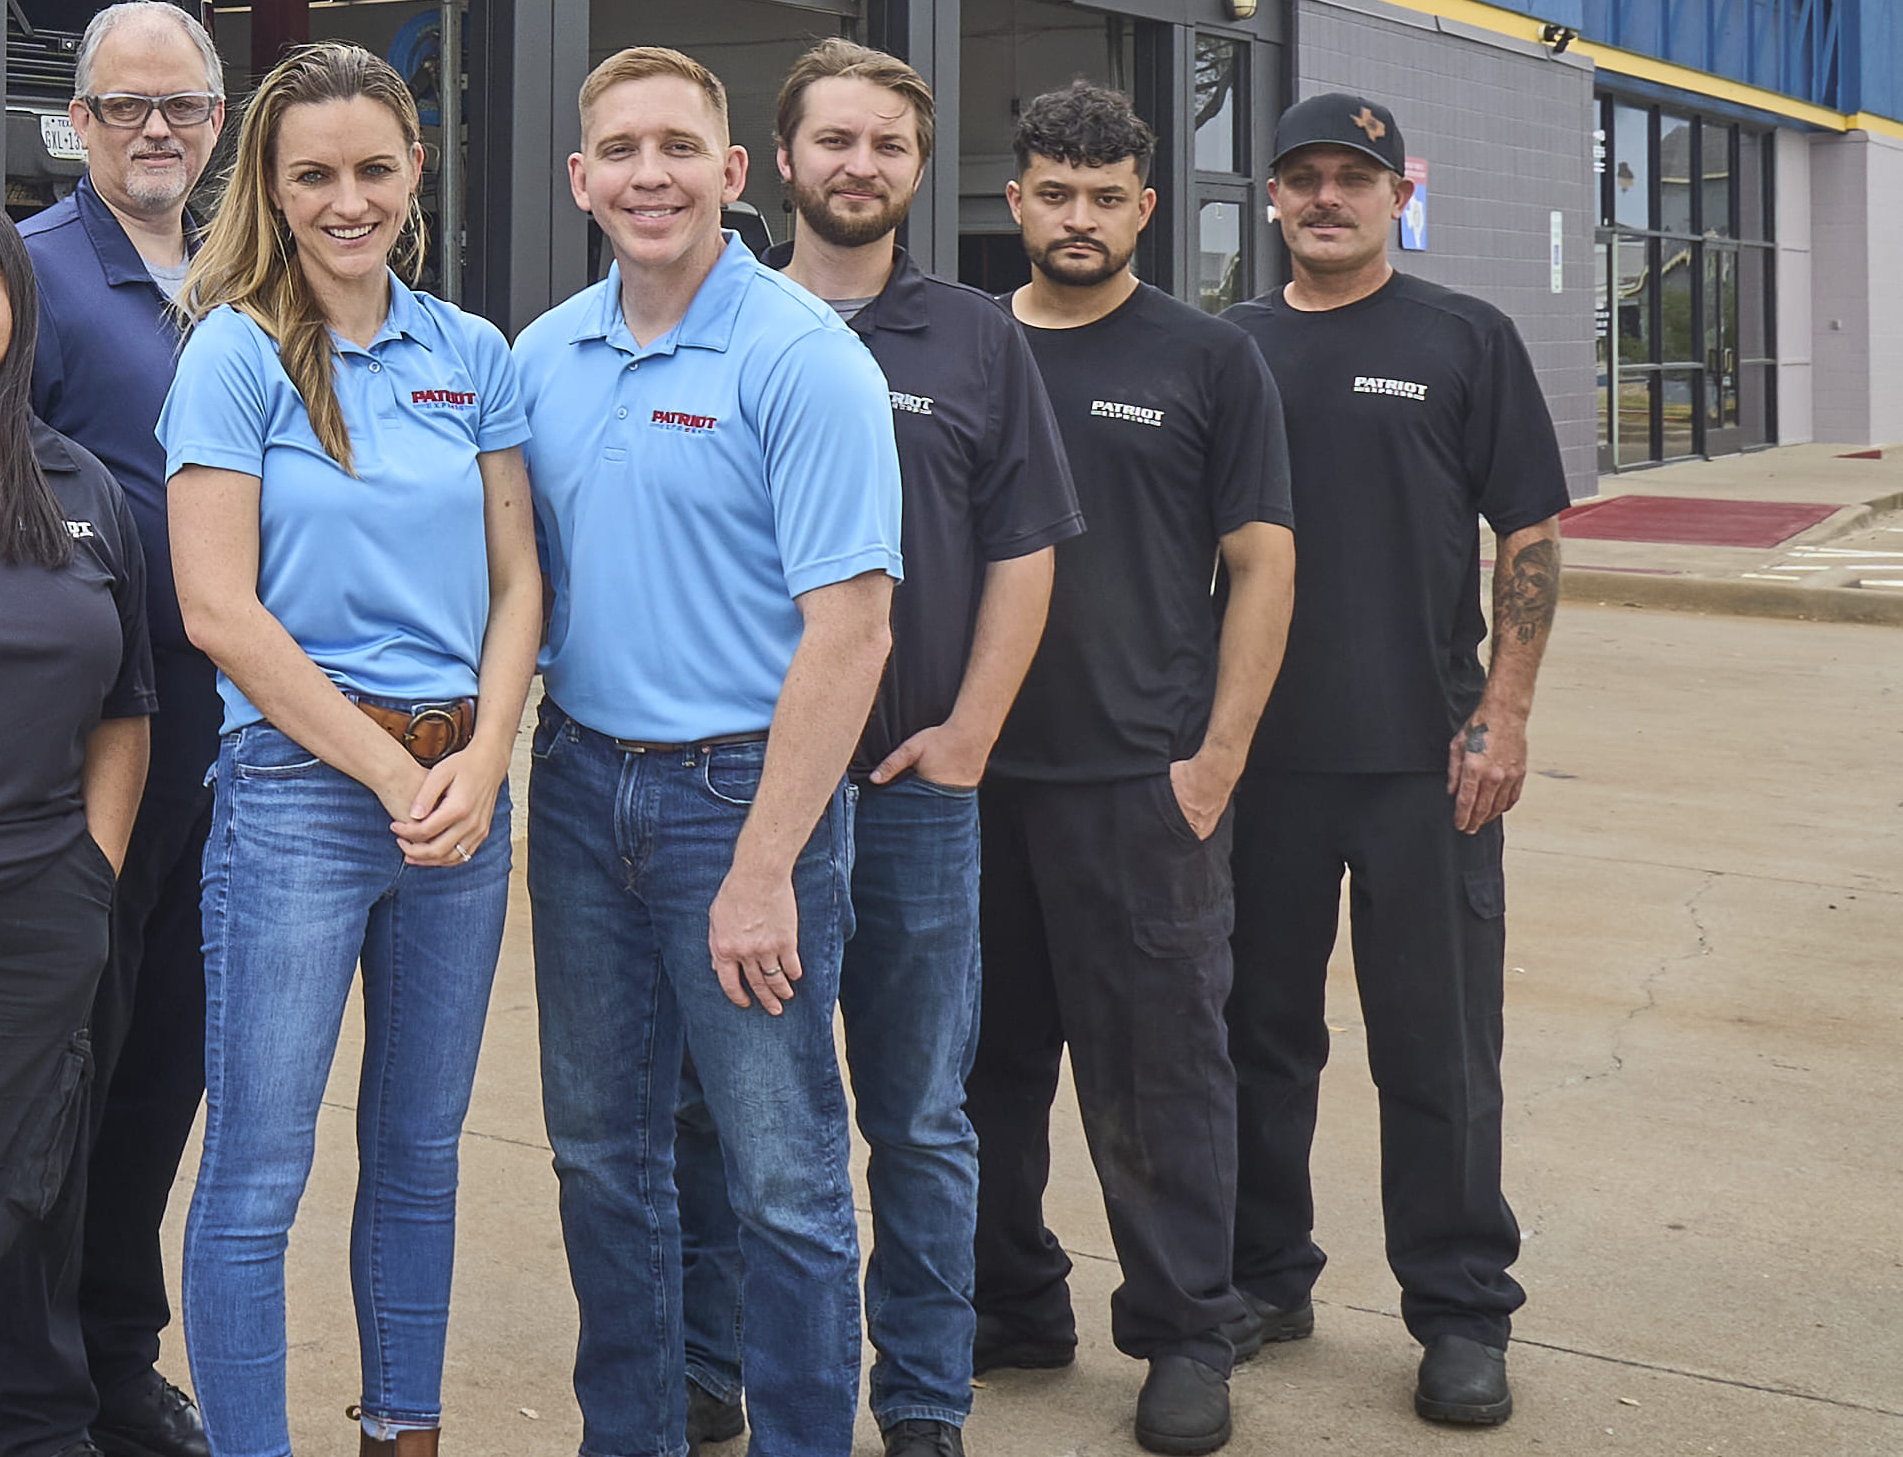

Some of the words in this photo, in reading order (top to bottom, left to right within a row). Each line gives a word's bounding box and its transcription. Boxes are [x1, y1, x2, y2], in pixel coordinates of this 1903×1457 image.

[1354, 376, 1428, 395] PATRIOT
[411, 389, 476, 405] PATRIOT
[889, 391, 935, 410] RIOT
[651, 410, 717, 429] PATRIOT
[1091, 400, 1165, 421] PATRIOT
